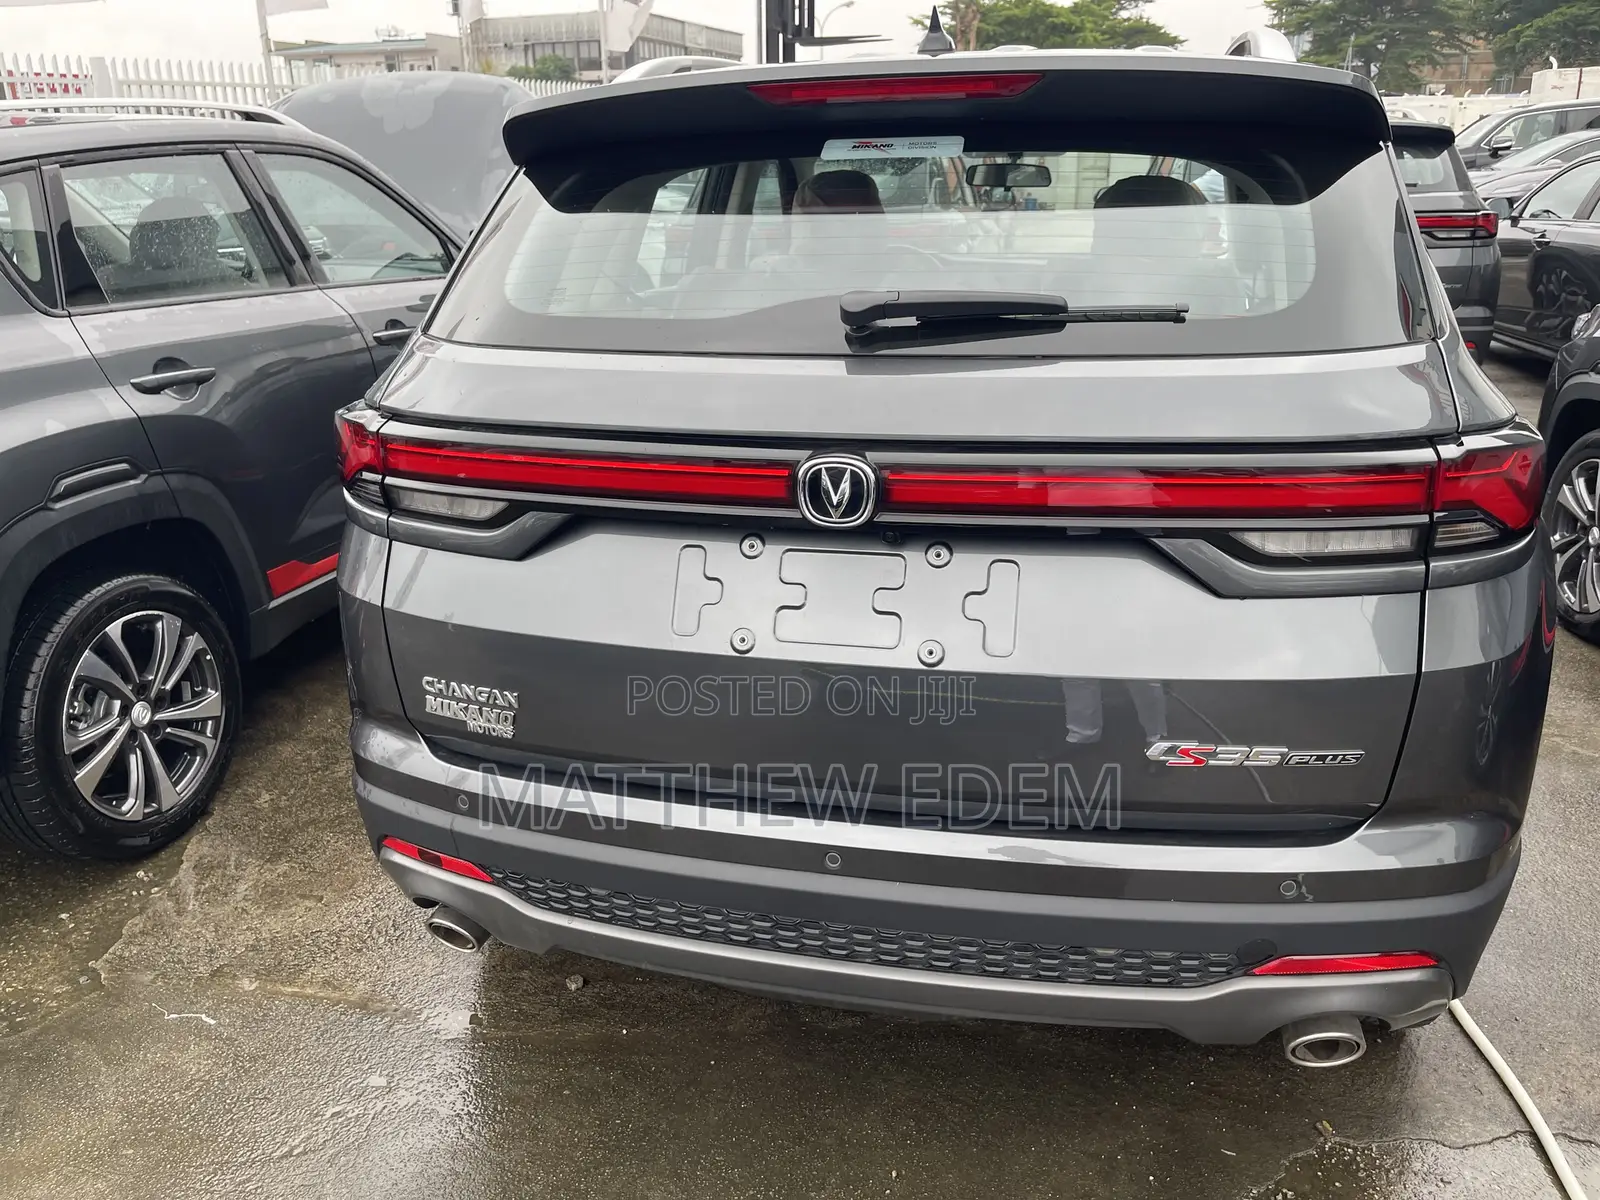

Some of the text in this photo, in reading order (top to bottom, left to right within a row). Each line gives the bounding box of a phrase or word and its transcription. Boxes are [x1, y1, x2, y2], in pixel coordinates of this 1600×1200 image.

[422, 676, 519, 708] CHANGAN
[425, 694, 516, 729] MIKANO
[466, 720, 515, 739] MOTORS
[1145, 740, 1361, 767] CS35 PLUS
